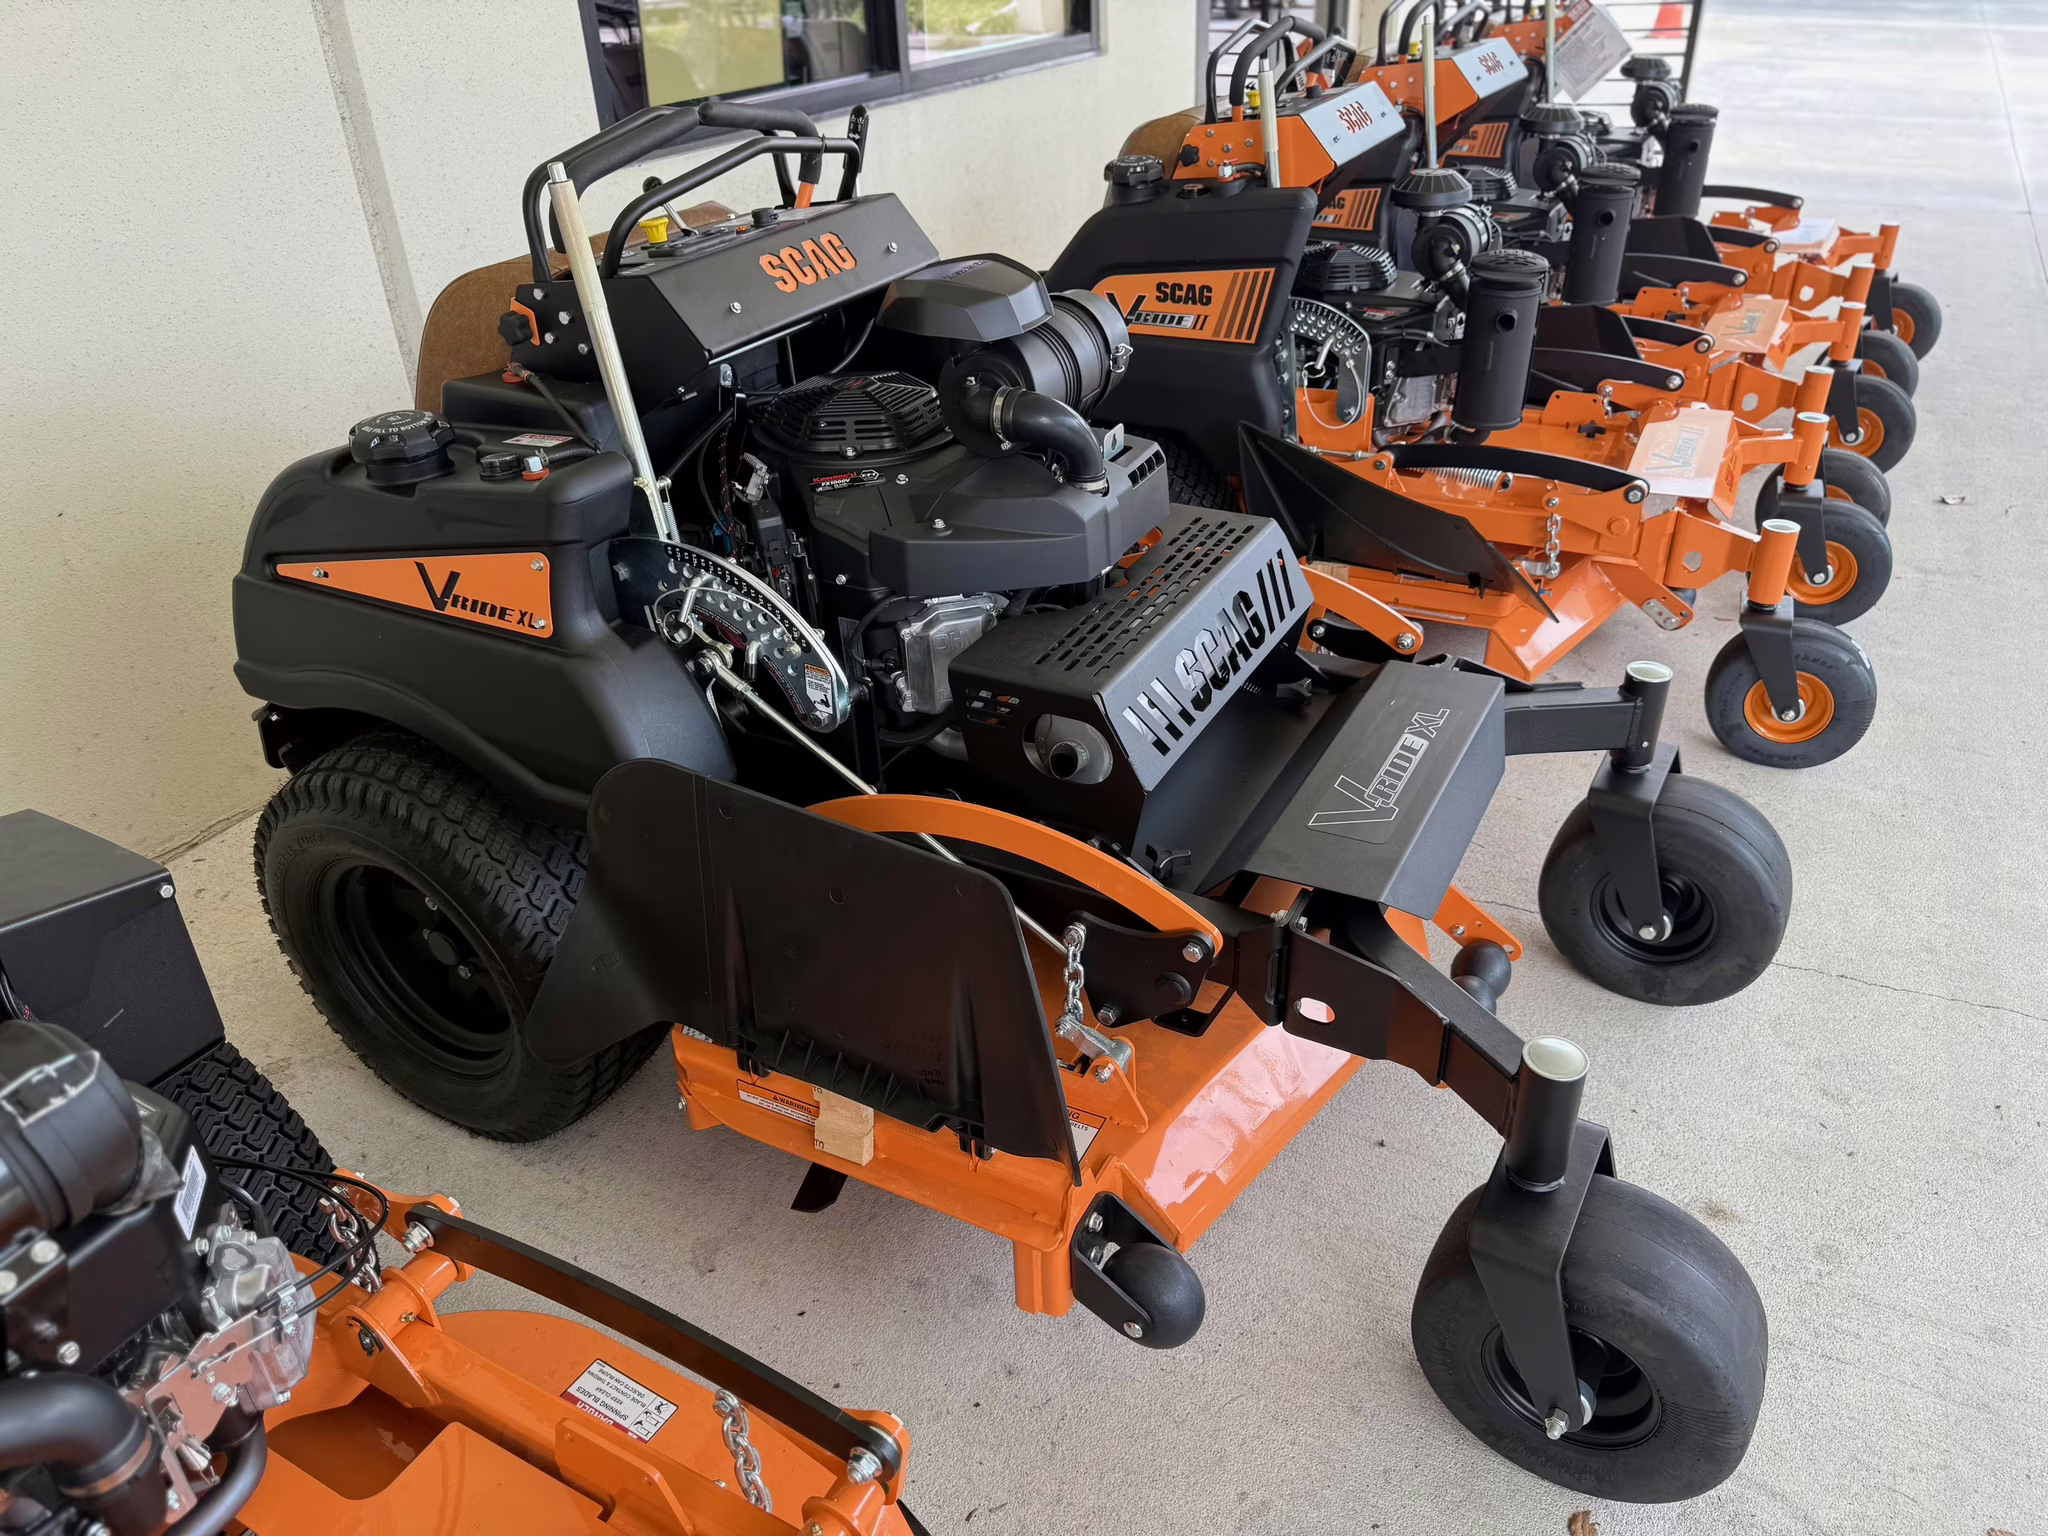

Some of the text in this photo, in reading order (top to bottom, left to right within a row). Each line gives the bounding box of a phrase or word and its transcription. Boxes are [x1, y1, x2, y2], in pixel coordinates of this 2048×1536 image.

[1477, 51, 1505, 76] SCAG
[1336, 100, 1373, 135] SCAG
[759, 231, 857, 294] SCAG
[1155, 281, 1213, 307] SCAG
[1174, 590, 1266, 713] SCAG
[1404, 708, 1451, 739] XL
[780, 1096, 812, 1114] WARNING
[587, 1369, 607, 1384] THROWN
[614, 1377, 625, 1386] CAN
[595, 1386, 623, 1405] KEEP CLEAR
[610, 1384, 632, 1399] CONTACT
[625, 1383, 646, 1399] OBJECTS
[630, 1396, 647, 1408] BLADE
[576, 1386, 629, 1421] SPINNING BLADES
